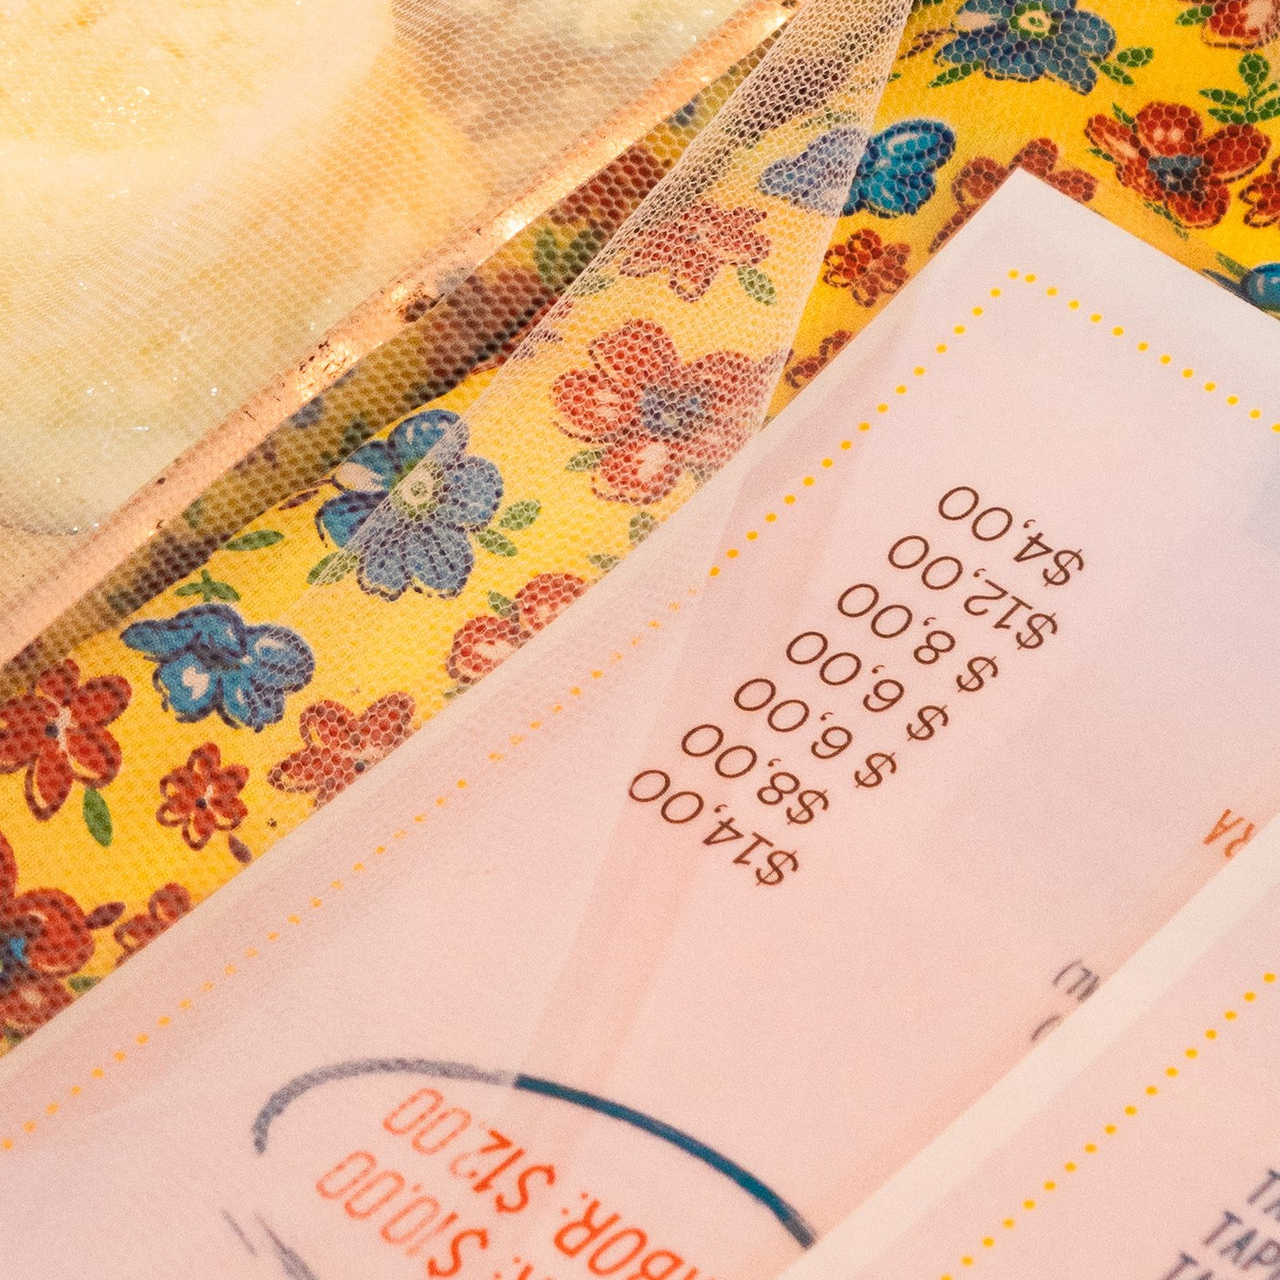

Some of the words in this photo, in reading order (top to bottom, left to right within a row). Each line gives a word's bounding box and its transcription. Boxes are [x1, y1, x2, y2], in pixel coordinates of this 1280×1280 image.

[938, 486, 1084, 587] $4,00
[888, 535, 1058, 649] $12,00
[628, 769, 799, 886] $14,00
[681, 724, 829, 825] $8,00
